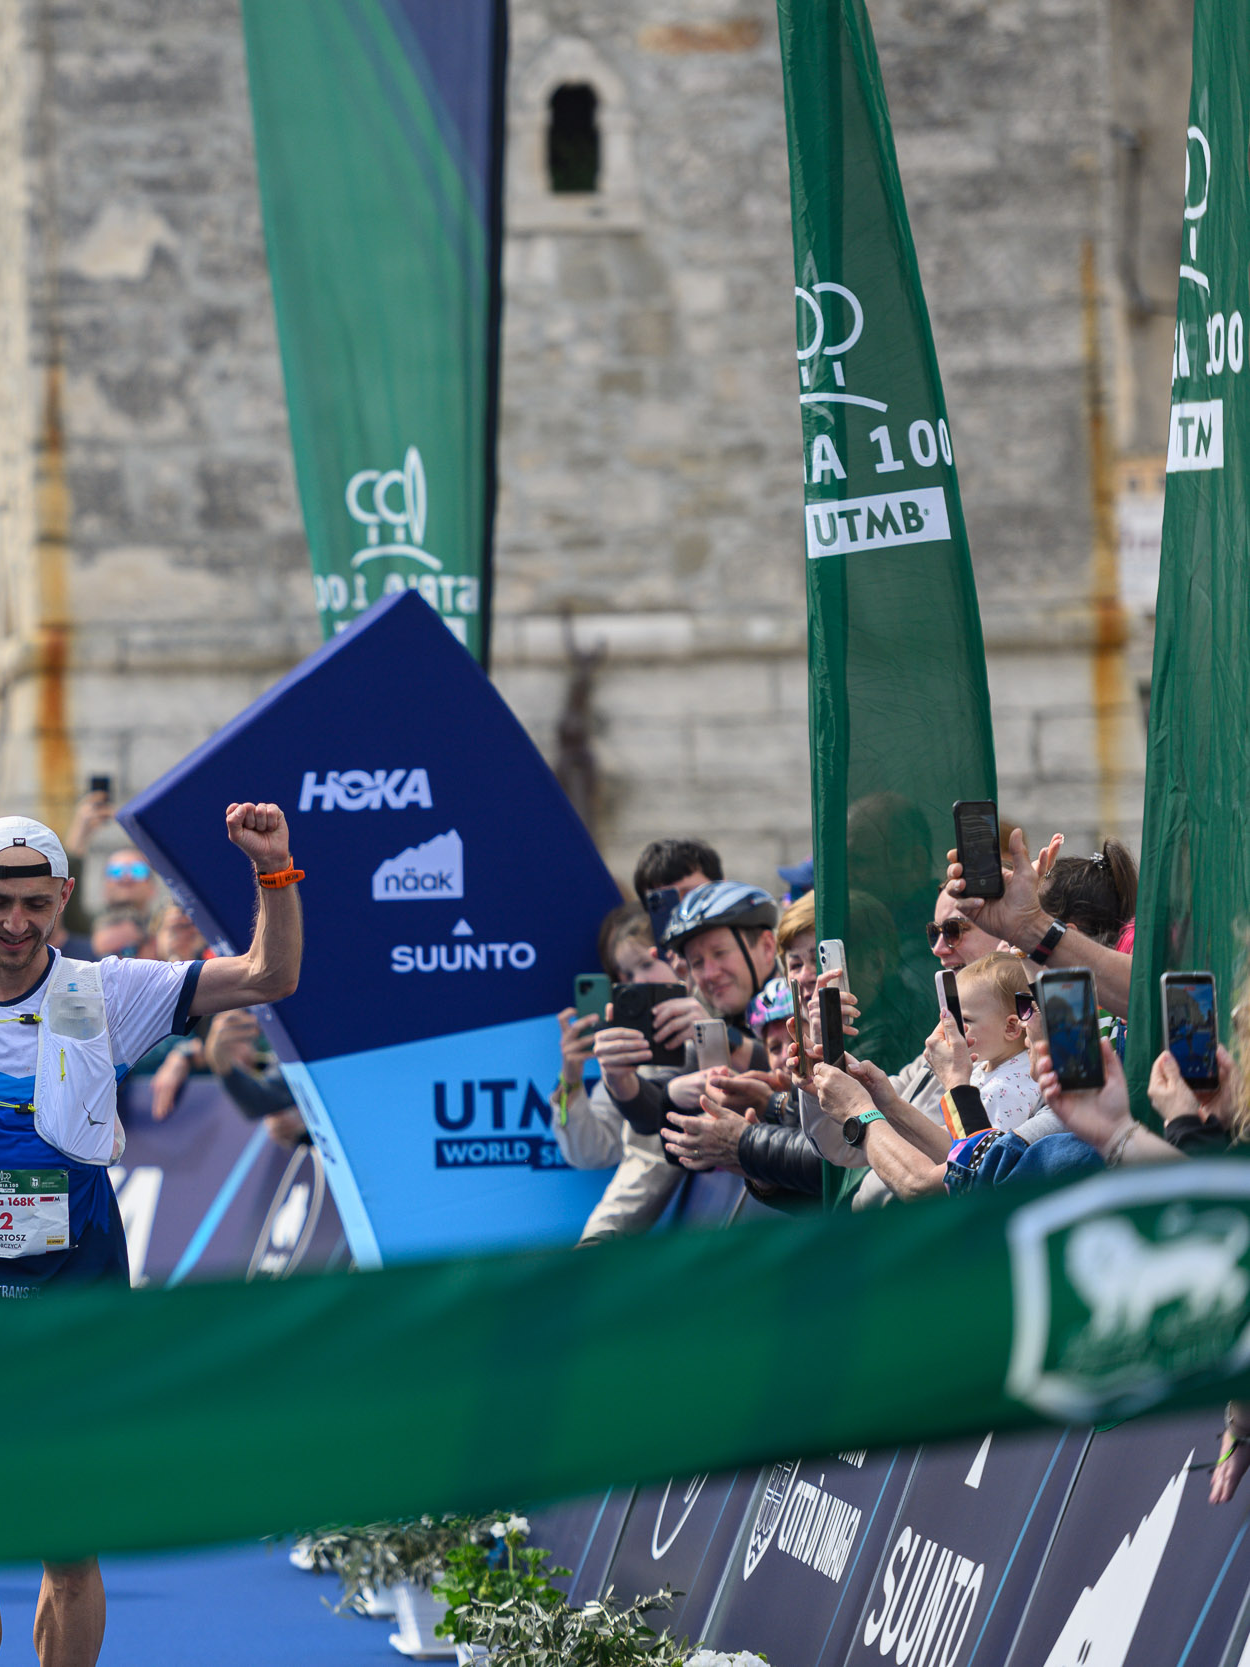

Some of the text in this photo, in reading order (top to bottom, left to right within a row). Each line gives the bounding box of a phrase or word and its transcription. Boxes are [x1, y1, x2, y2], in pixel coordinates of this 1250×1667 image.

[869, 418, 953, 473] 100
[298, 768, 433, 812] HOKA
[384, 867, 454, 891] näak
[391, 942, 536, 973] SUUNTO
[442, 1141, 531, 1164] WORLD
[7, 1197, 36, 1207] 168K
[0, 1212, 13, 1230] 2
[864, 1526, 985, 1667] SUUNTO
